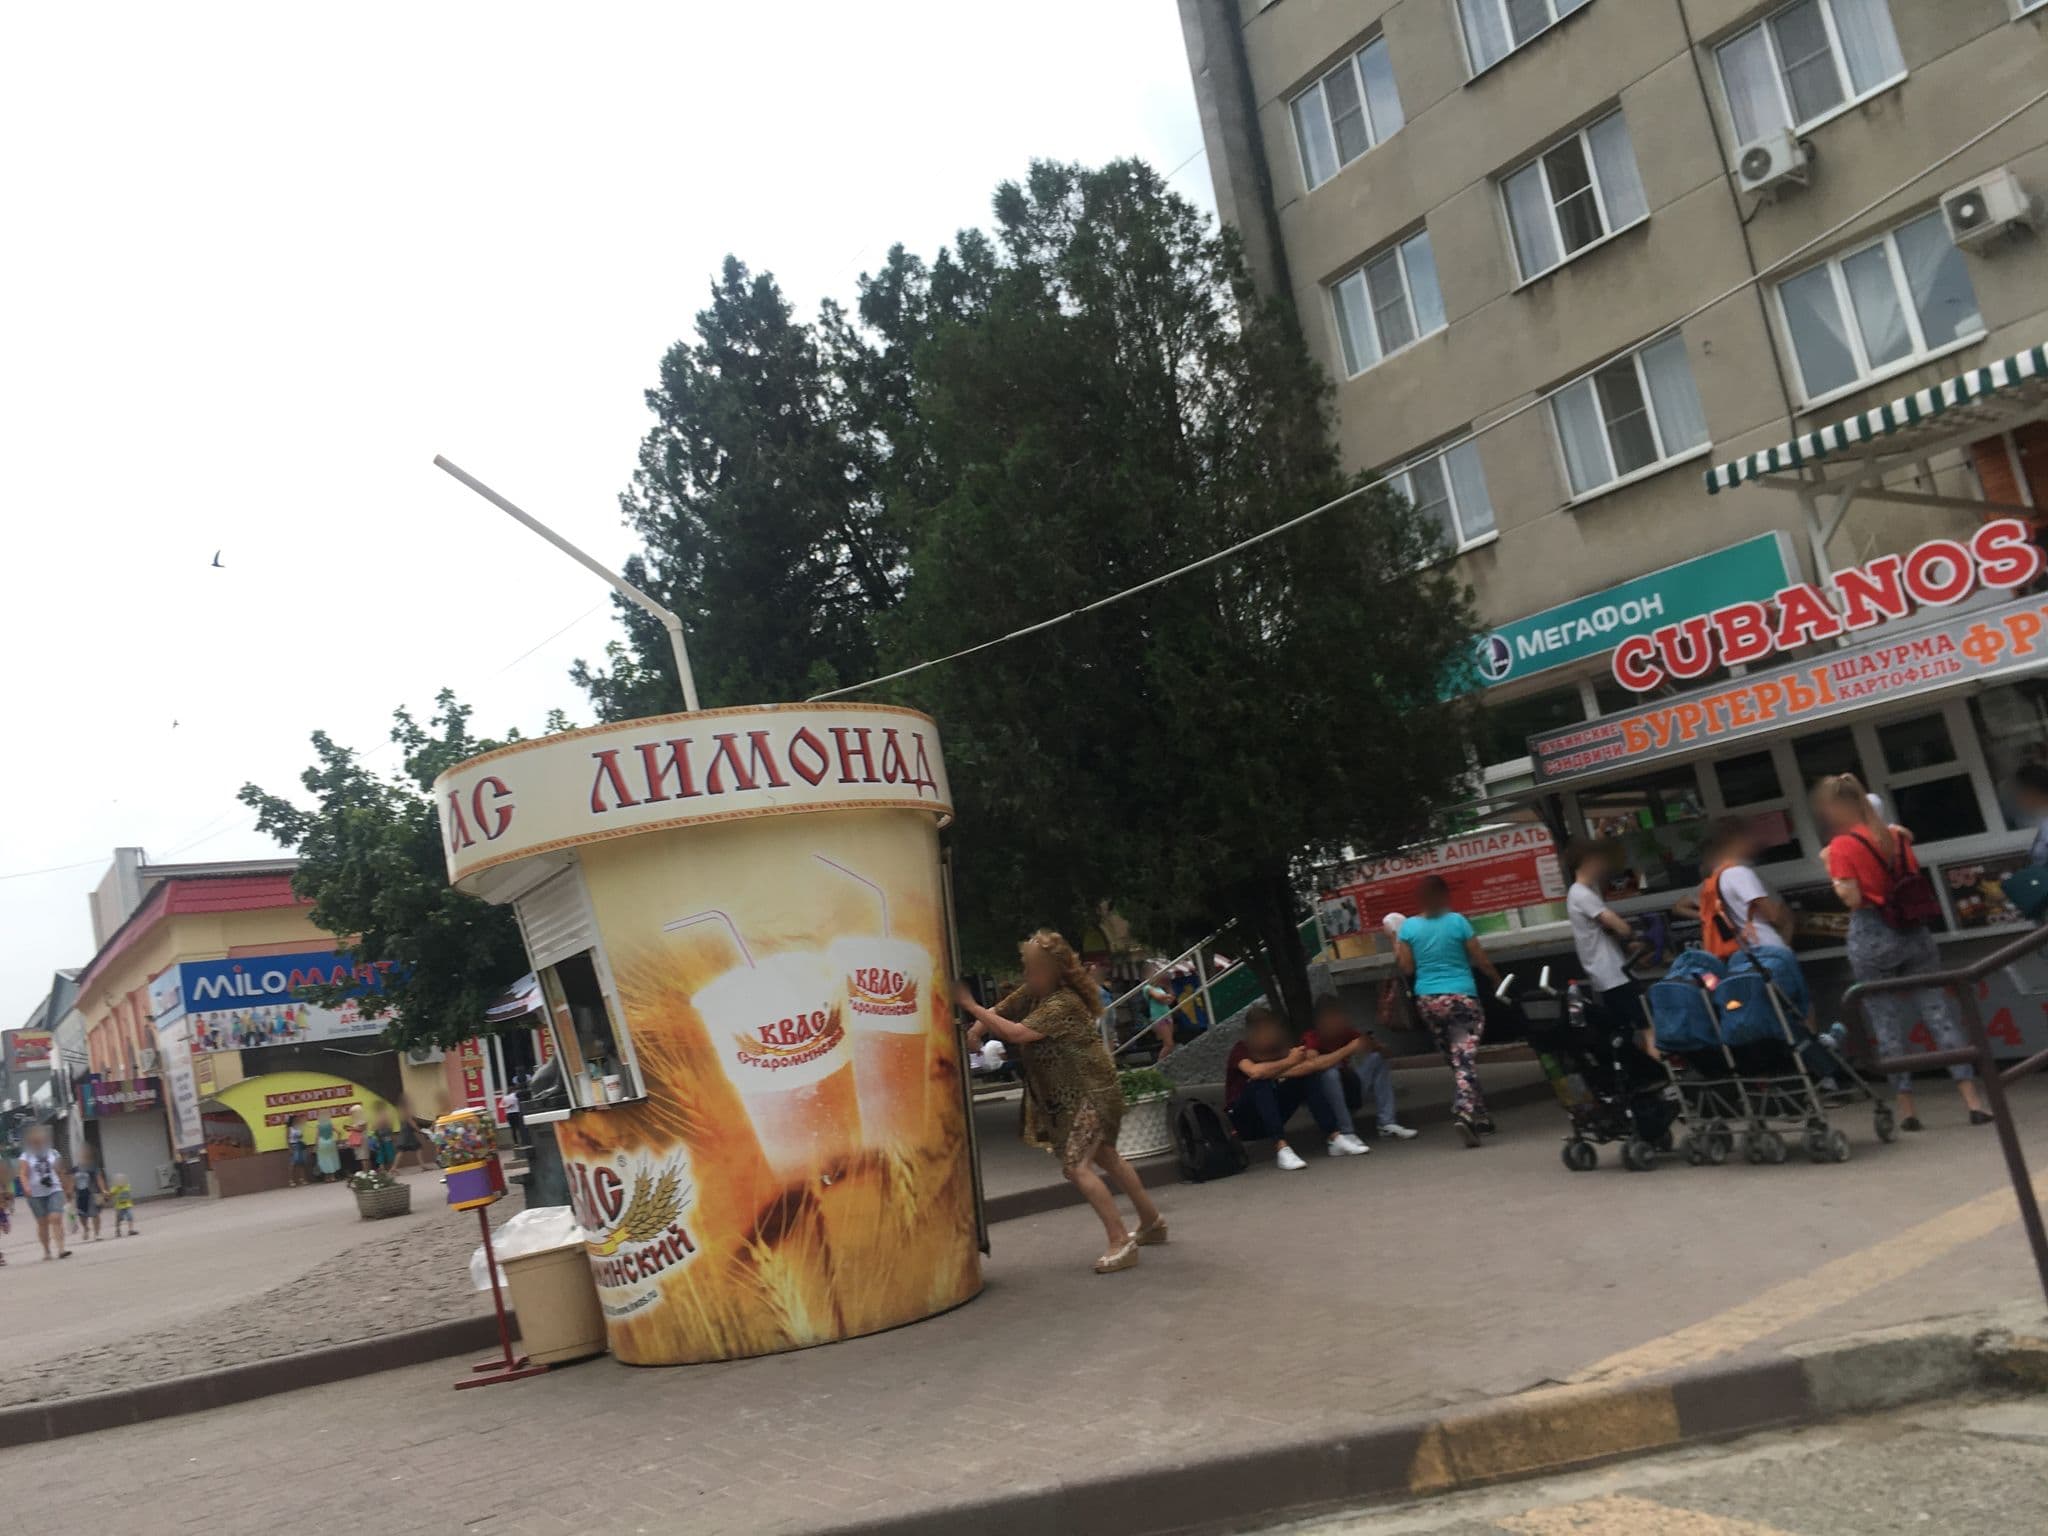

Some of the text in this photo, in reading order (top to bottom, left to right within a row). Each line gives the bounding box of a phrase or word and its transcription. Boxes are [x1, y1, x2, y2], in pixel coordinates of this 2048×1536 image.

[1516, 593, 1664, 660] МЕГАФОН
[1612, 518, 2041, 692] CUBANOS
[1831, 634, 1956, 681] ШАУРМА
[1838, 658, 1962, 700] КАРТОФЕЛЬ
[1619, 666, 1836, 753] БУРГЕРЫ
[1543, 742, 1624, 776] СЭНДВИЧИ
[448, 725, 938, 854] АС ЛИМОНАД
[856, 968, 904, 995] КВАС
[757, 1010, 826, 1045] КВАС
